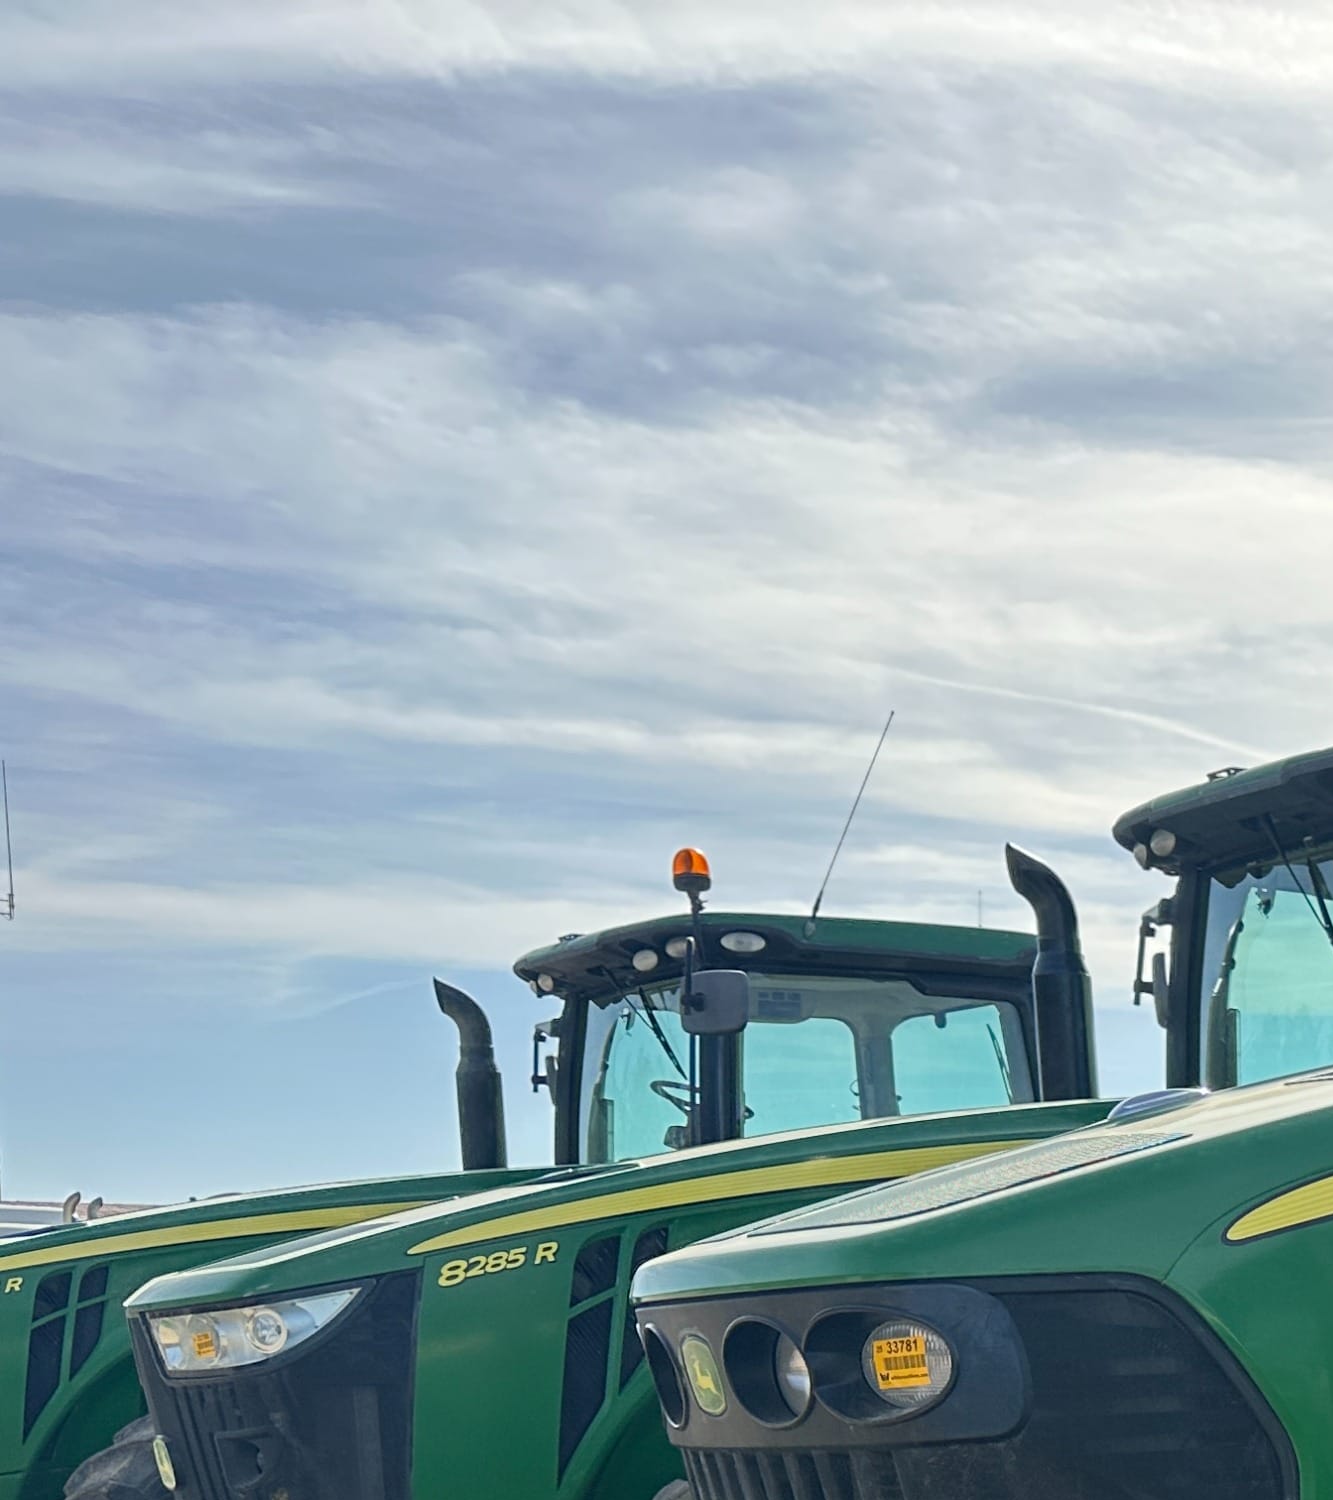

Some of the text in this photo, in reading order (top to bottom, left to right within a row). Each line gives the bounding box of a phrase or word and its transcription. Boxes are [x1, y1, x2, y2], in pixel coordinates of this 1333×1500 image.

[437, 1241, 559, 1287] 8285 R
[4, 1277, 24, 1293] R
[886, 1339, 918, 1354] 33781
